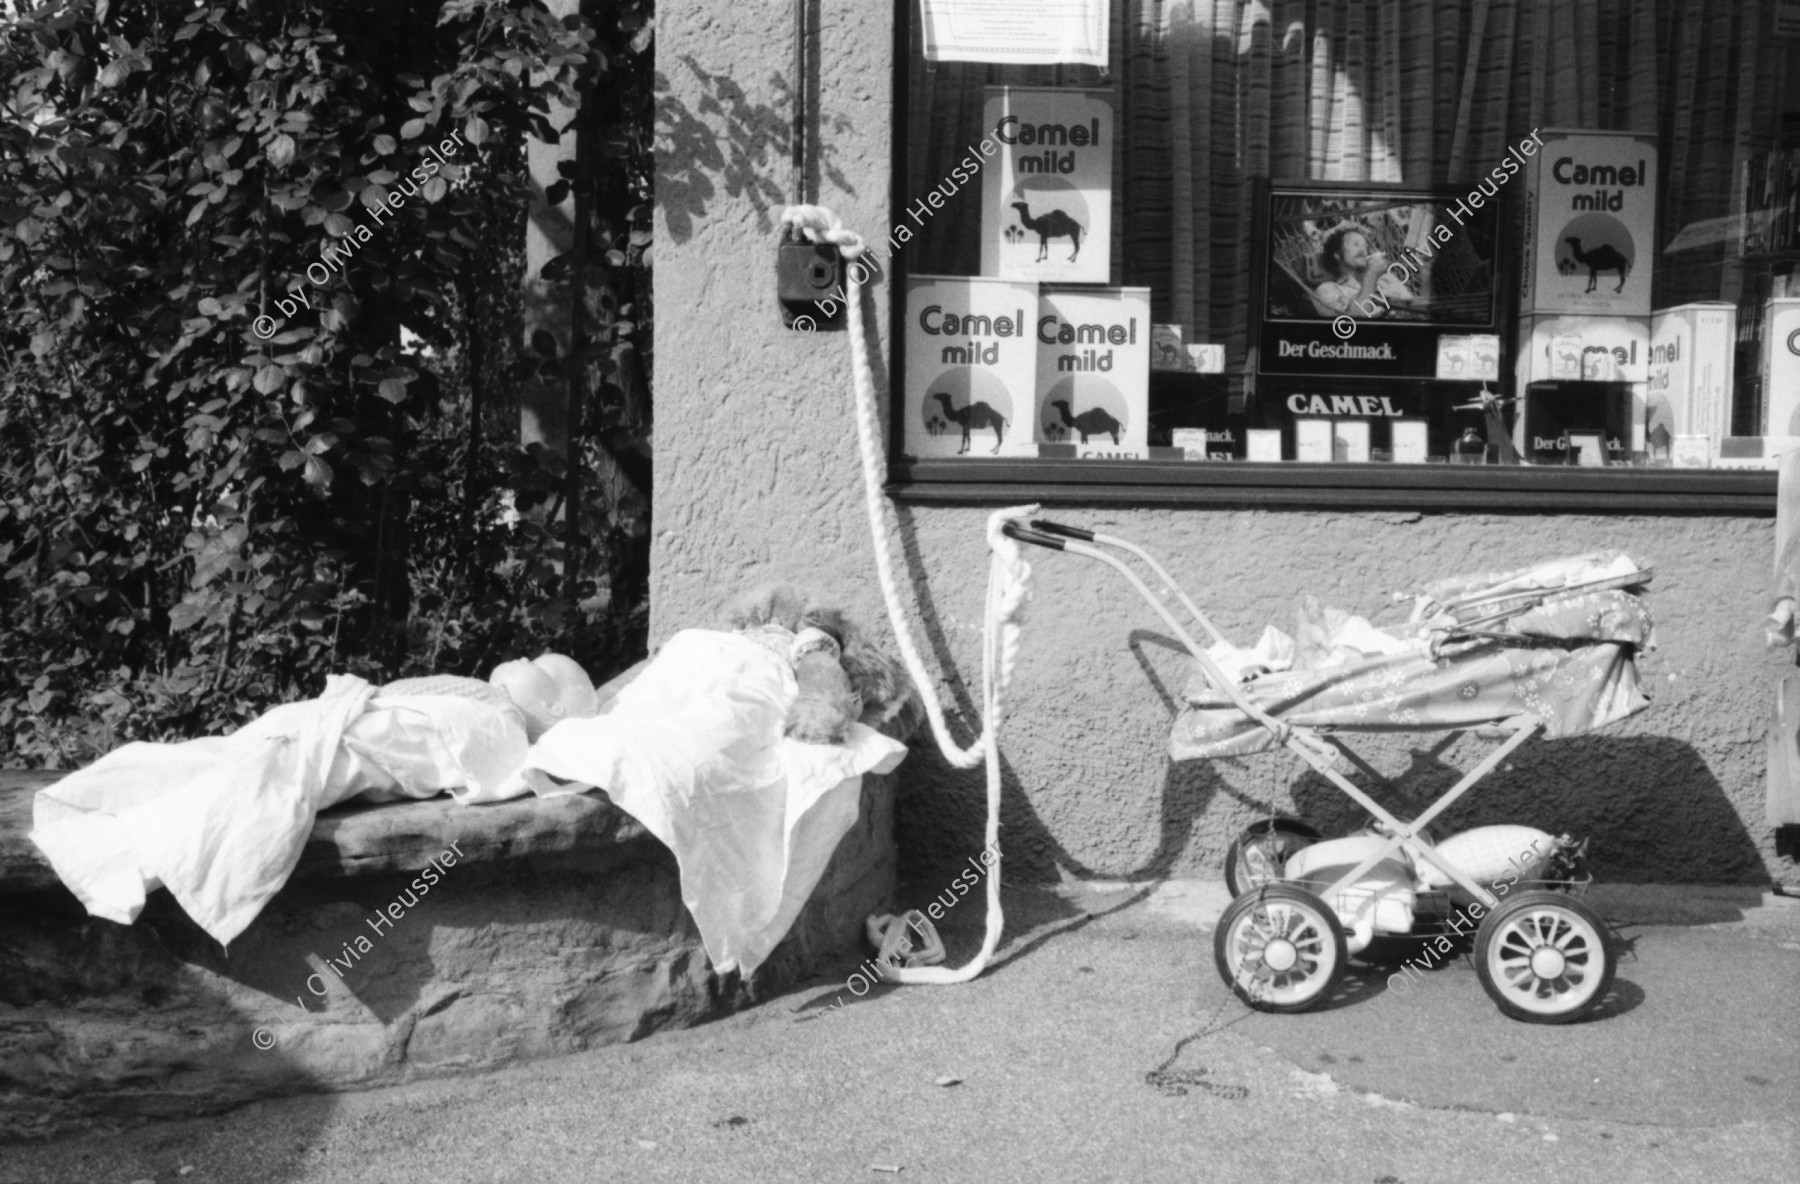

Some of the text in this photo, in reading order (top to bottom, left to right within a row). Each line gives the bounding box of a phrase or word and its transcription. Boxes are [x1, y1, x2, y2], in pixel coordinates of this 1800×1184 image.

[998, 115, 1099, 147] Camel
[1018, 150, 1076, 174] mild
[1553, 156, 1646, 187] Camel
[1571, 189, 1624, 212] mild
[919, 304, 1024, 337] Camel
[1037, 315, 1137, 345] Camel
[941, 341, 999, 365] mild
[1057, 349, 1114, 372] mild
[1278, 339, 1397, 360] Der Geschmack.
[1286, 393, 1404, 417] CAMEL
[1533, 436, 1556, 451] Der
